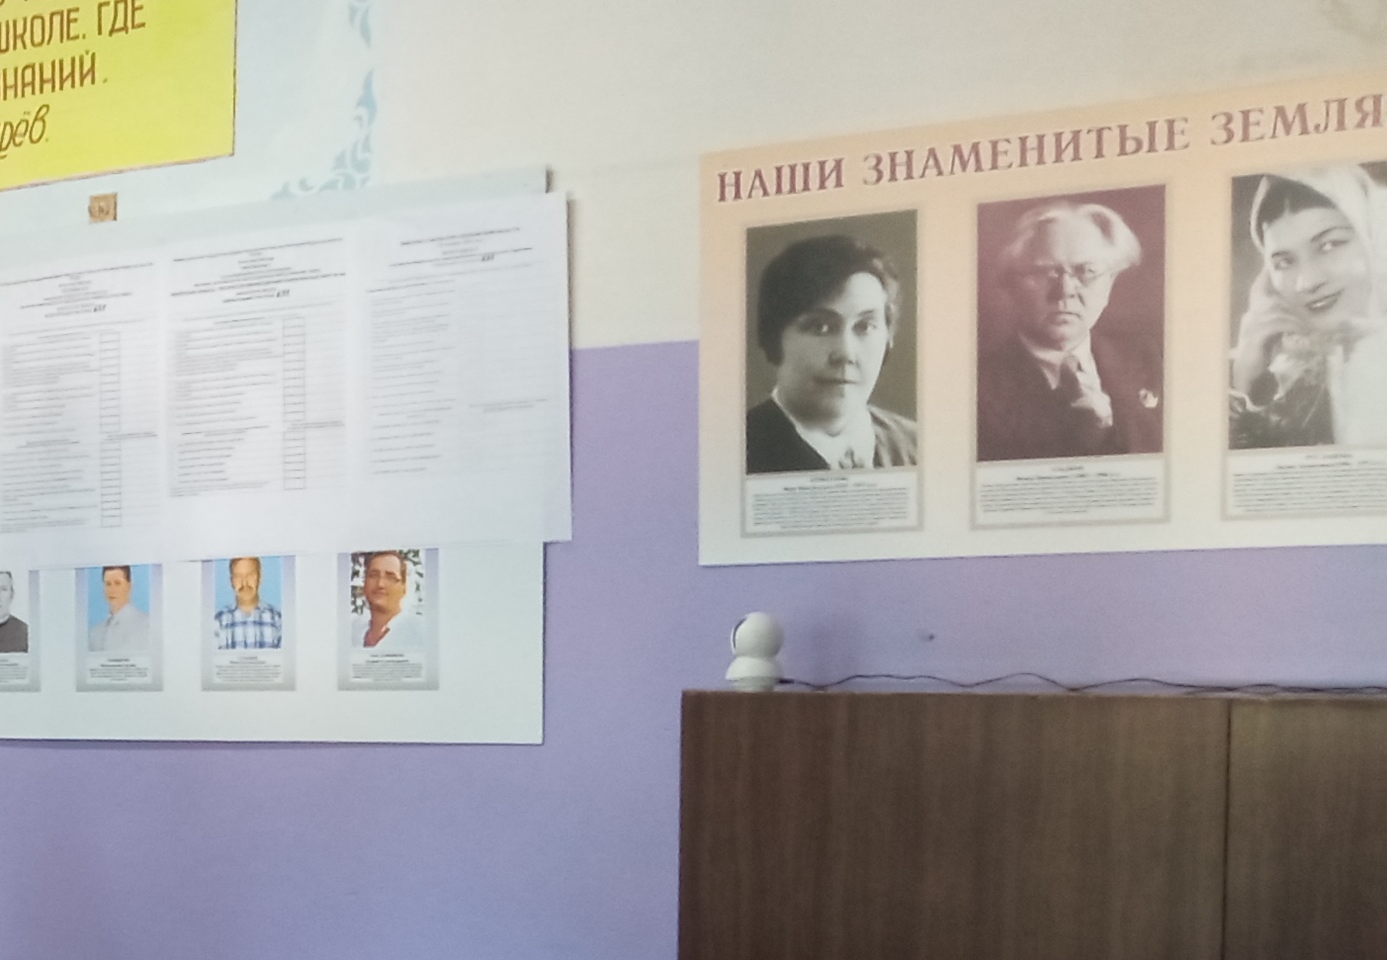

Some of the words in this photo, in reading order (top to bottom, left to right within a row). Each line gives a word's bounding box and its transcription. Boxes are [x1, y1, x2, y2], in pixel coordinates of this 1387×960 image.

[97, 0, 147, 38] ГДЕ
[716, 156, 846, 203] НАШИ
[861, 115, 1191, 186] ЗНАМЕНИТЫЕ
[1209, 93, 1385, 146] ЗЕМЛЯ
